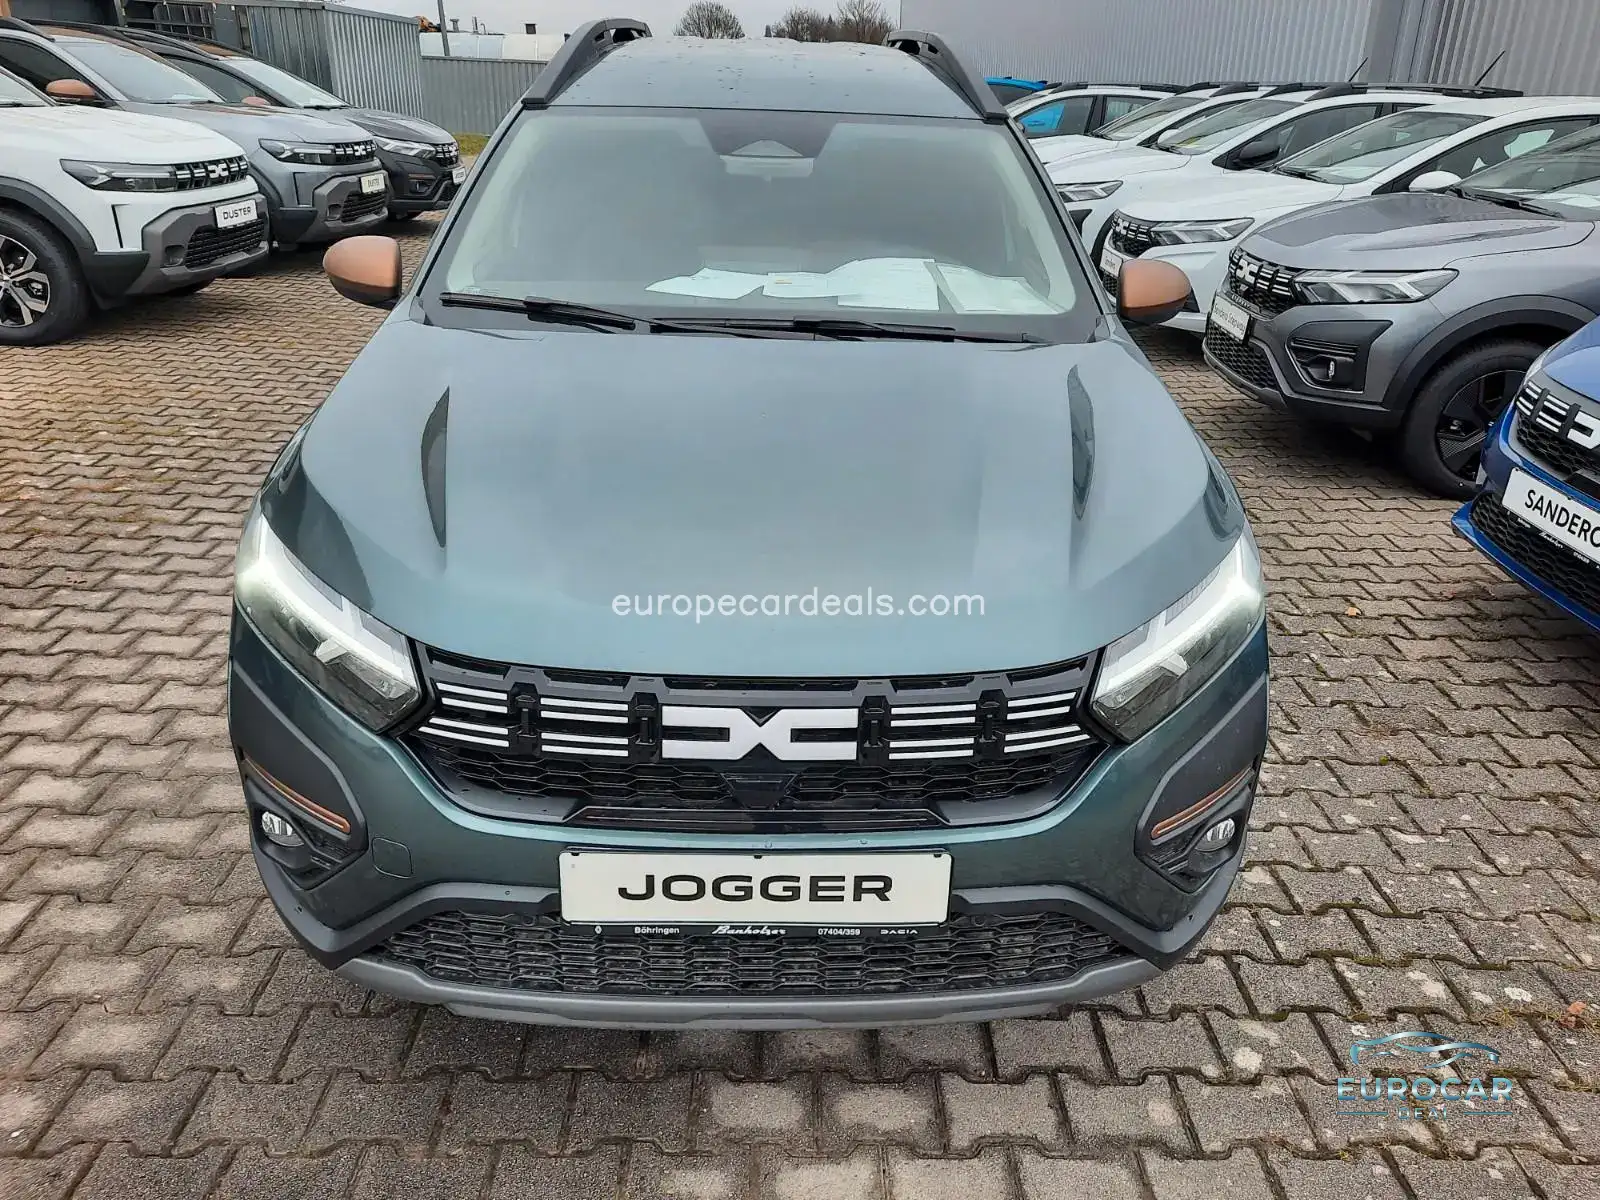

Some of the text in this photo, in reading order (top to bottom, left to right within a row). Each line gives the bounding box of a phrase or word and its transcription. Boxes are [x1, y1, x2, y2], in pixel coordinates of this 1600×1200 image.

[223, 206, 251, 220] DUSTER
[617, 874, 893, 902] JOGGER
[634, 926, 680, 936] Böhringen
[817, 928, 861, 936] 07404/359
